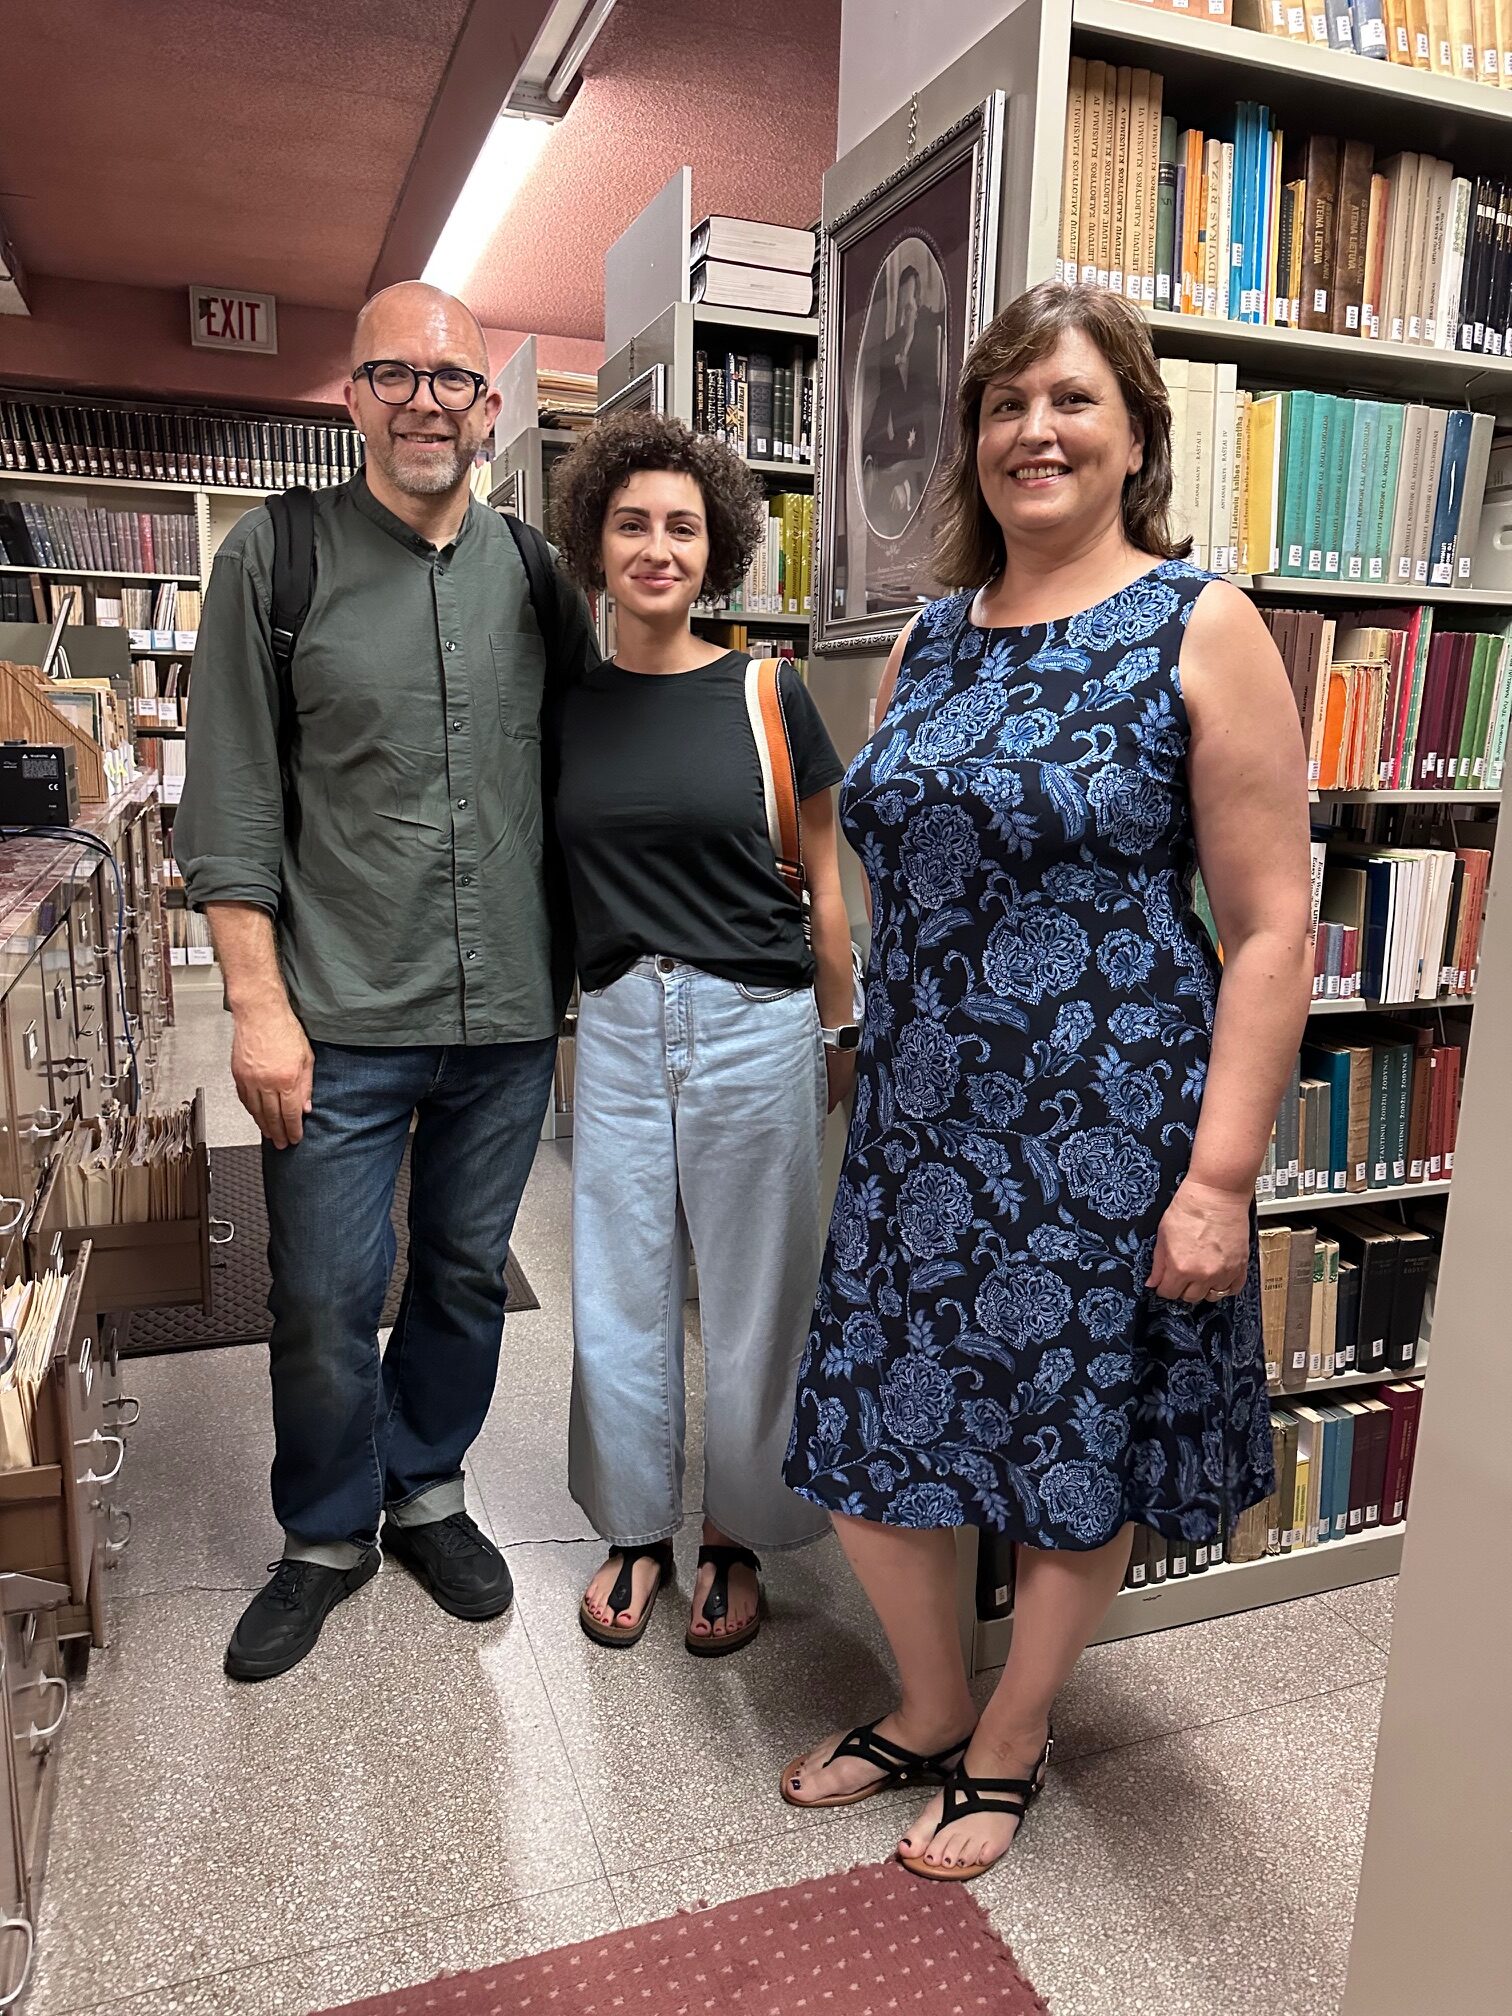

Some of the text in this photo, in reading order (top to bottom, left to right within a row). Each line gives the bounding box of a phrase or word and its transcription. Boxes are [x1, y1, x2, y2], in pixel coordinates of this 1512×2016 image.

[1091, 111, 1100, 158] KLAUSIMAI
[1105, 110, 1113, 156] KLAUSIMAI
[1090, 162, 1098, 218] KALBOTYROS
[1102, 160, 1111, 215] KALBOTYROS
[1116, 168, 1124, 222] KALBOTYROS
[1132, 108, 1145, 271] LIETUVIŲ KALBOTYROS KLAUSIMAI VI
[1088, 222, 1096, 261] LIETUVIŲ
[1208, 213, 1217, 284] UDVIKAS
[1314, 199, 1325, 264] ATEINA LIETUVA
[1348, 205, 1359, 269] ATEINA LIETUVA
[207, 297, 260, 341] EXIT
[1319, 416, 1328, 468] INTRODUCTION
[1360, 422, 1371, 473] INTRODUCTION
[1383, 425, 1393, 476] INTRODUCTION
[1429, 430, 1439, 481] INTRODUCTION
[1318, 471, 1324, 481] TO
[1337, 474, 1342, 484] TO
[1360, 476, 1365, 486] TO
[1382, 480, 1387, 488] TO
[1404, 427, 1422, 557] INTRODUCTION TO MODERN LITHUANI
[1428, 484, 1433, 493] TO
[1424, 495, 1432, 524] MODERN
[1353, 520, 1362, 557] LITHUANIA
[1375, 522, 1383, 558] LITHUANIA
[1314, 899, 1319, 908] To
[1379, 1055, 1389, 1161] TAUTINIŲ ŽODŽIŲ ŽODYNAS
[1398, 1052, 1409, 1159] TAUTINIŲ ŽODŽIŲ ŽODYNAS
